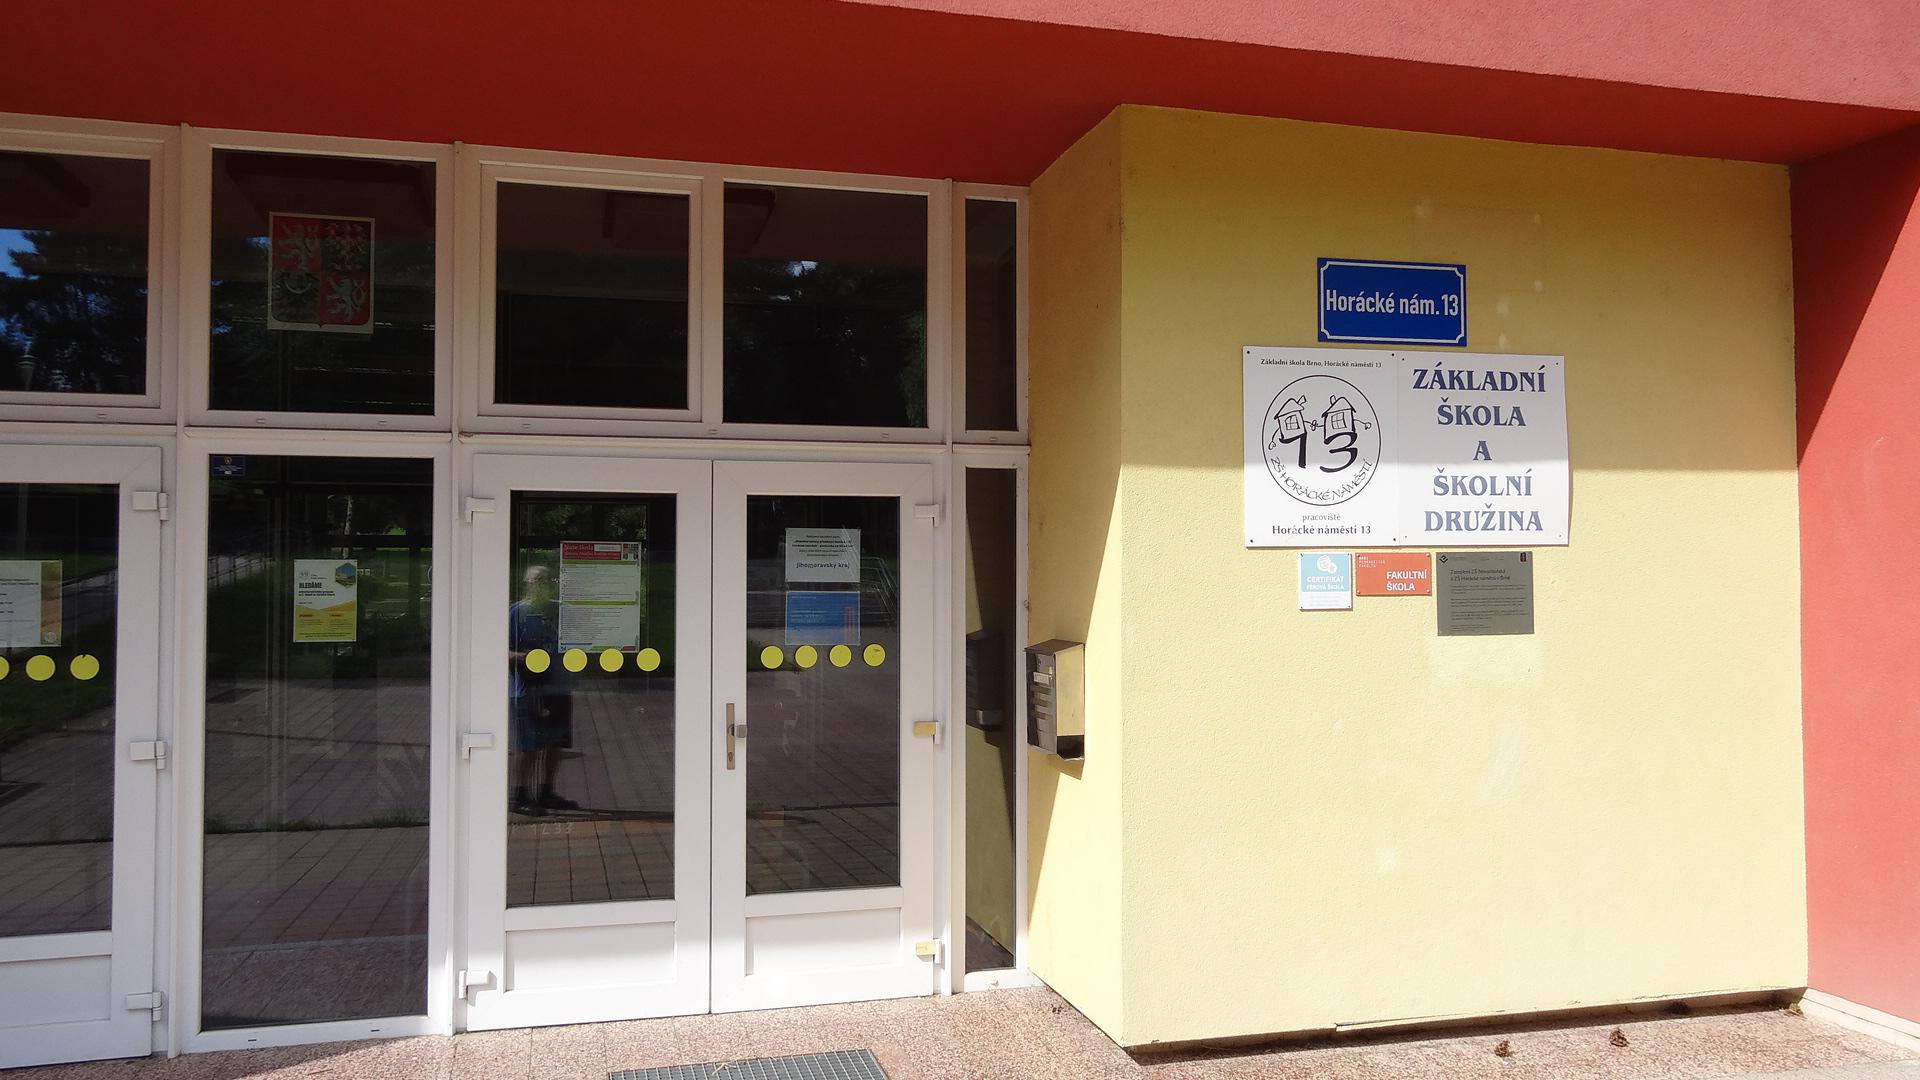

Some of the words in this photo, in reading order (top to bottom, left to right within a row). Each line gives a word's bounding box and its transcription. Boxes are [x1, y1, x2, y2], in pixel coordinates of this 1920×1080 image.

[1326, 289, 1395, 314] Horácké
[1399, 293, 1440, 315] nám.
[1441, 294, 1459, 316] 13
[1260, 358, 1288, 366] Základní
[1289, 359, 1305, 367] škola
[1324, 360, 1350, 368] Horácké
[1412, 361, 1546, 393] ZÁKLADNÍ
[1437, 397, 1526, 427] ŠKOLA
[1473, 440, 1493, 461] A
[1279, 470, 1331, 501] HORÁCKÉ
[1331, 457, 1373, 501] NÁMĚSTÍ
[1433, 467, 1533, 497] ŠKOLNÍ
[1272, 524, 1315, 535] Horácké
[1317, 524, 1357, 535] náměstí
[1361, 525, 1371, 535] 13
[1302, 513, 1341, 523] pracoviště
[1424, 503, 1544, 532] DRUŽINA
[1386, 569, 1427, 580] FAKULTNÍ
[1386, 582, 1416, 591] ŠKOLA
